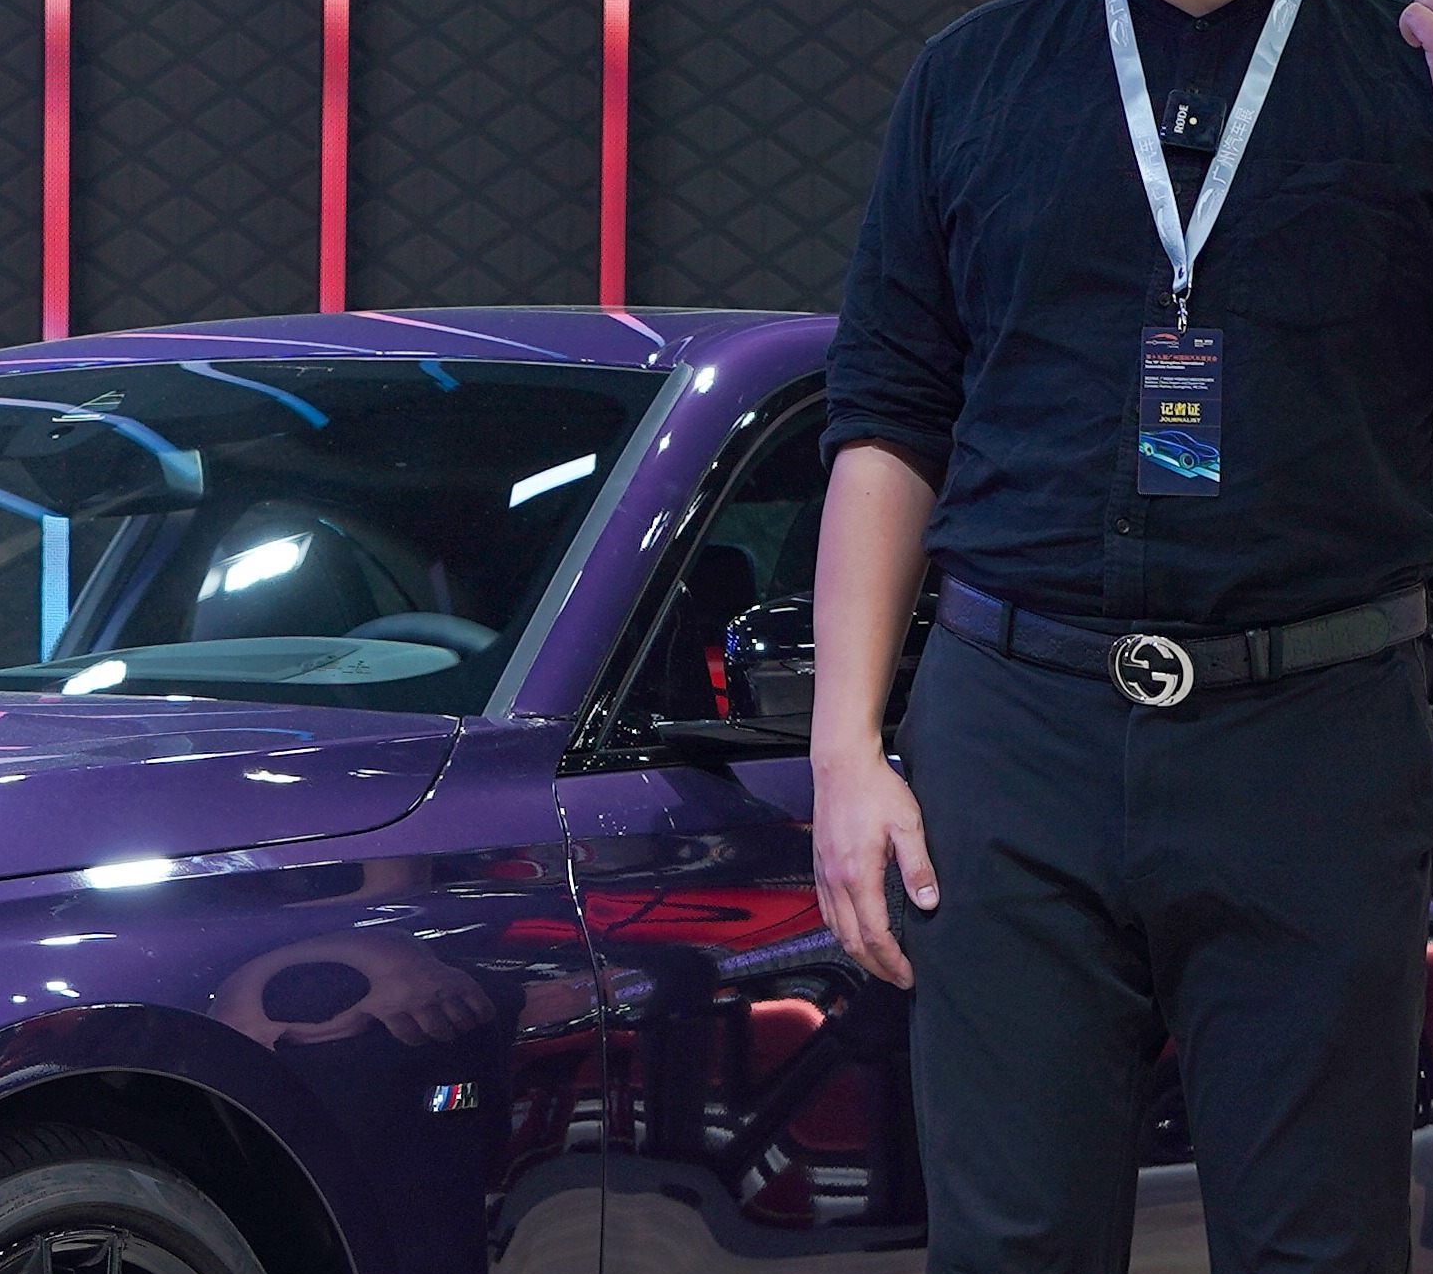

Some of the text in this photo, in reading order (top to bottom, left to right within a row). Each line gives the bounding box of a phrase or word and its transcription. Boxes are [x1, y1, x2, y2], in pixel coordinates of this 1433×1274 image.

[1212, 107, 1256, 185] 广州汽车展
[1160, 401, 1200, 416] 记者证
